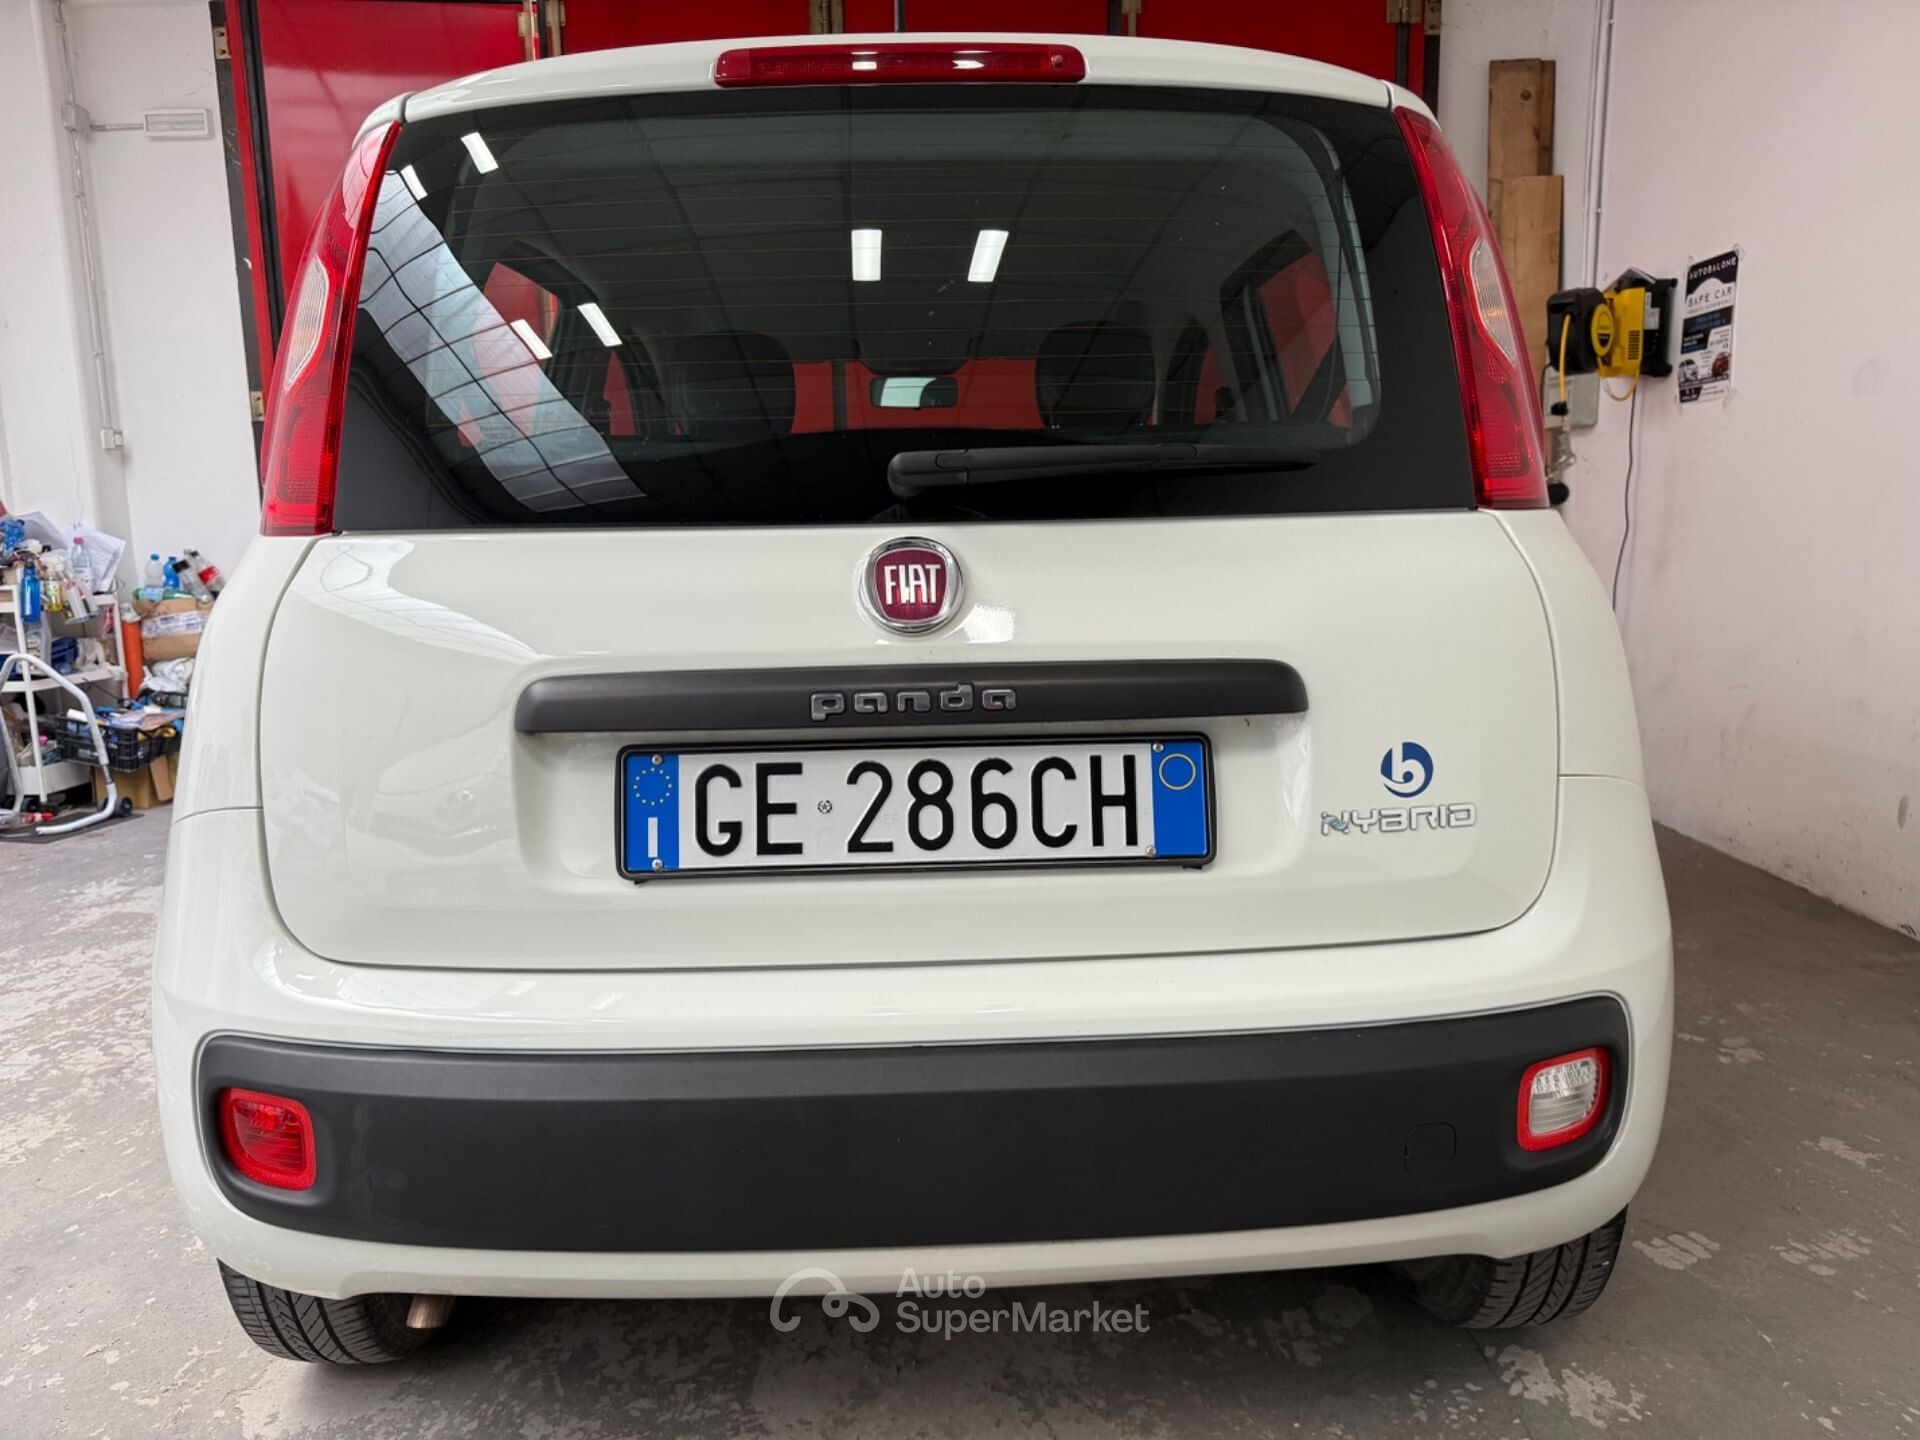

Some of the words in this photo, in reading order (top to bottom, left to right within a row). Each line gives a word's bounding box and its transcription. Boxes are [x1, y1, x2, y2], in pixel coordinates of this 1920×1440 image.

[1688, 292, 1711, 308] SAFE
[1714, 286, 1732, 300] CAR
[884, 564, 941, 605] FIAT
[811, 684, 1016, 721] panda
[694, 762, 803, 856] GE
[846, 753, 1138, 853] 286CH
[1321, 802, 1476, 836] HYBRID
